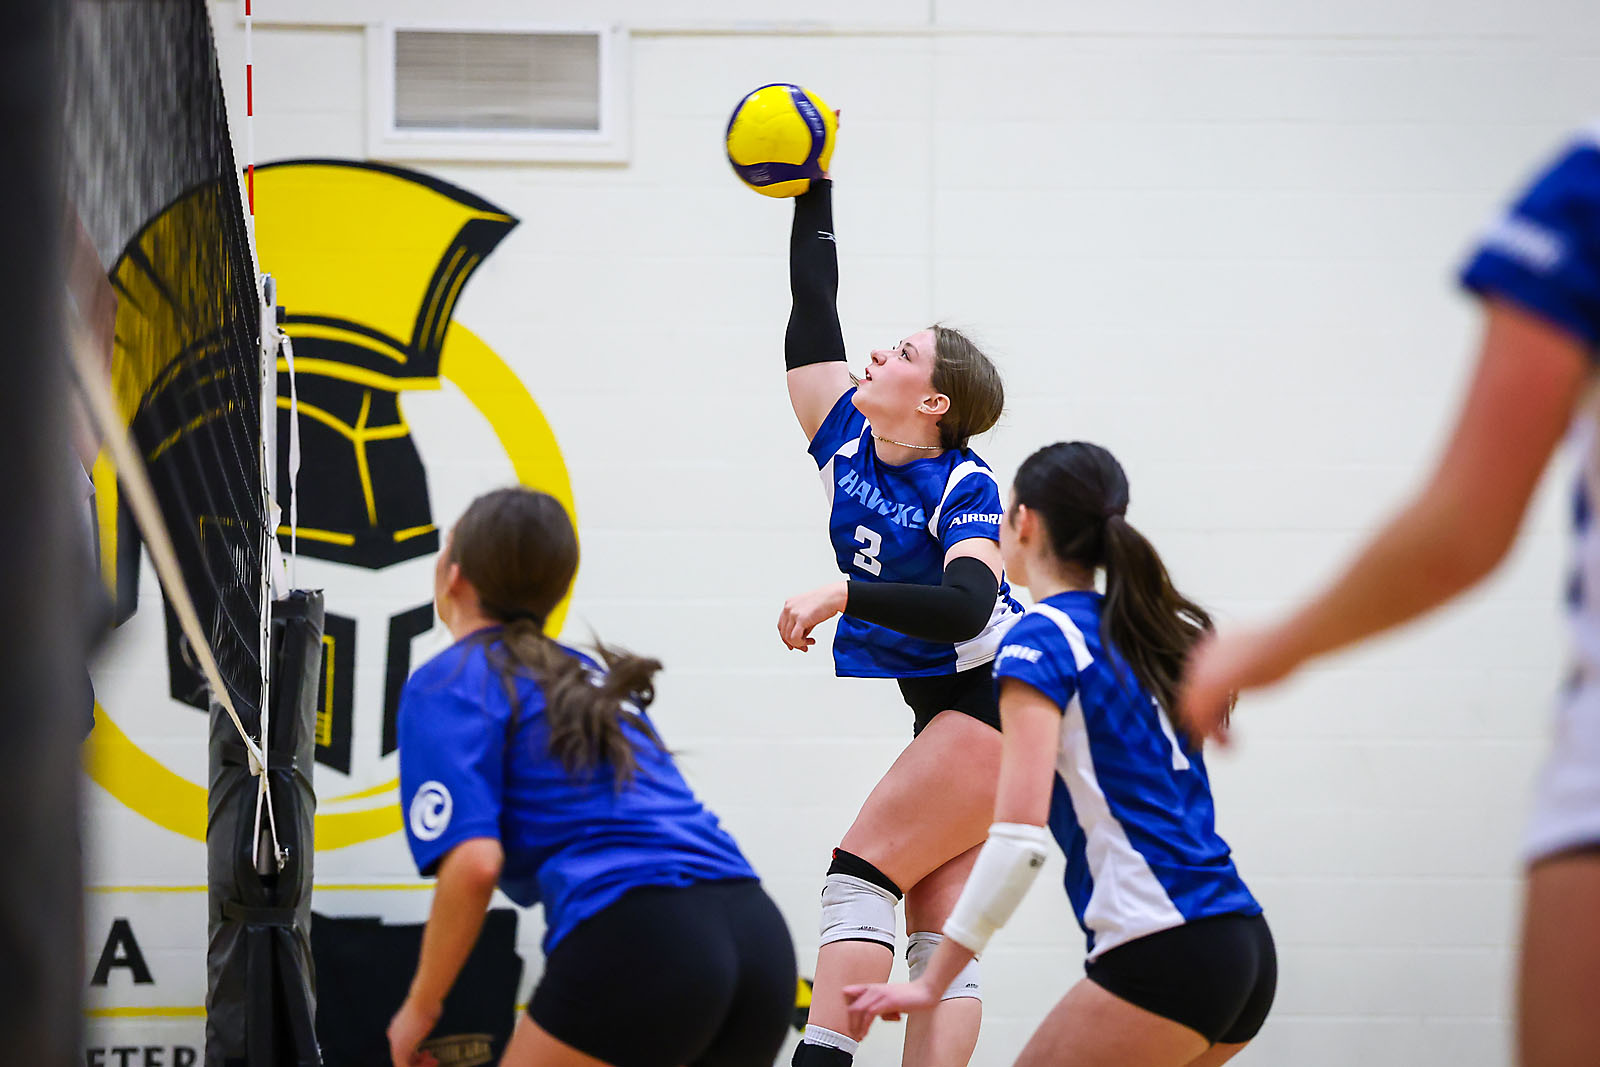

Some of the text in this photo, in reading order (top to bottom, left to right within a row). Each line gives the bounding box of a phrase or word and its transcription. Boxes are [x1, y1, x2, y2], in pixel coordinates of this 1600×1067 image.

[837, 469, 927, 530] HAWKS
[853, 524, 882, 577] 3
[90, 918, 155, 986] A
